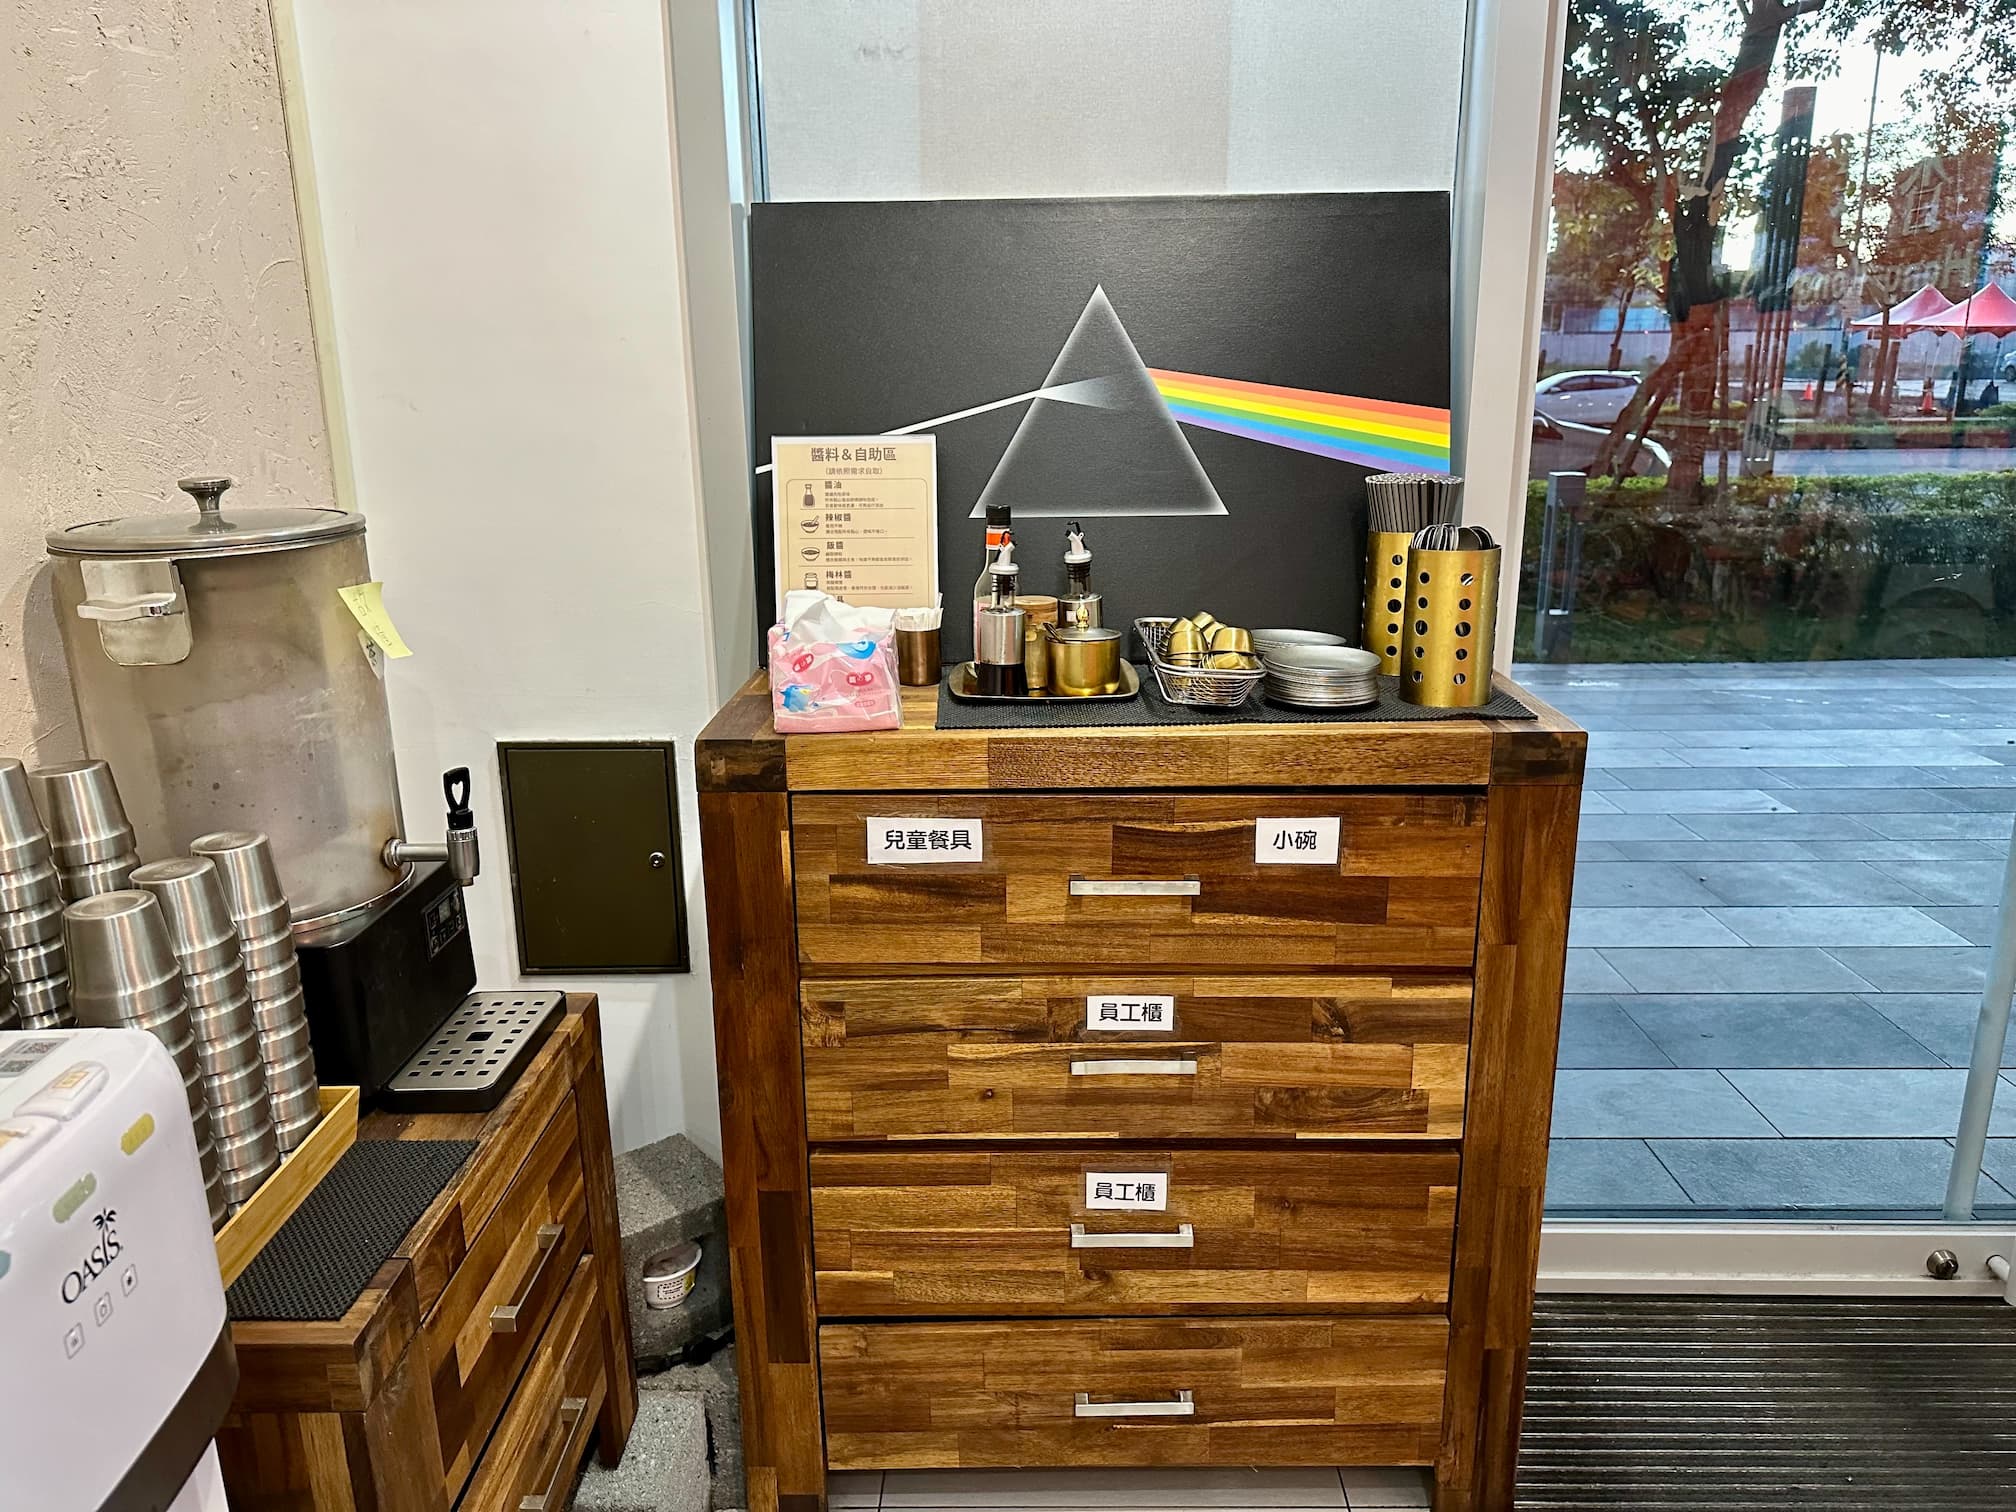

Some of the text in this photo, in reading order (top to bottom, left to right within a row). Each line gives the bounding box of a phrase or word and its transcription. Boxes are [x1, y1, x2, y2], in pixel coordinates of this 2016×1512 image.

[825, 480, 842, 489] 醬油
[825, 513, 852, 522] 辣椒醬
[884, 829, 972, 851] 兒童餐具
[1272, 830, 1318, 851] 小碗
[1098, 1002, 1163, 1023] 員工櫃
[1093, 1182, 1156, 1203] 員工櫃
[61, 1226, 121, 1305] OASIS
